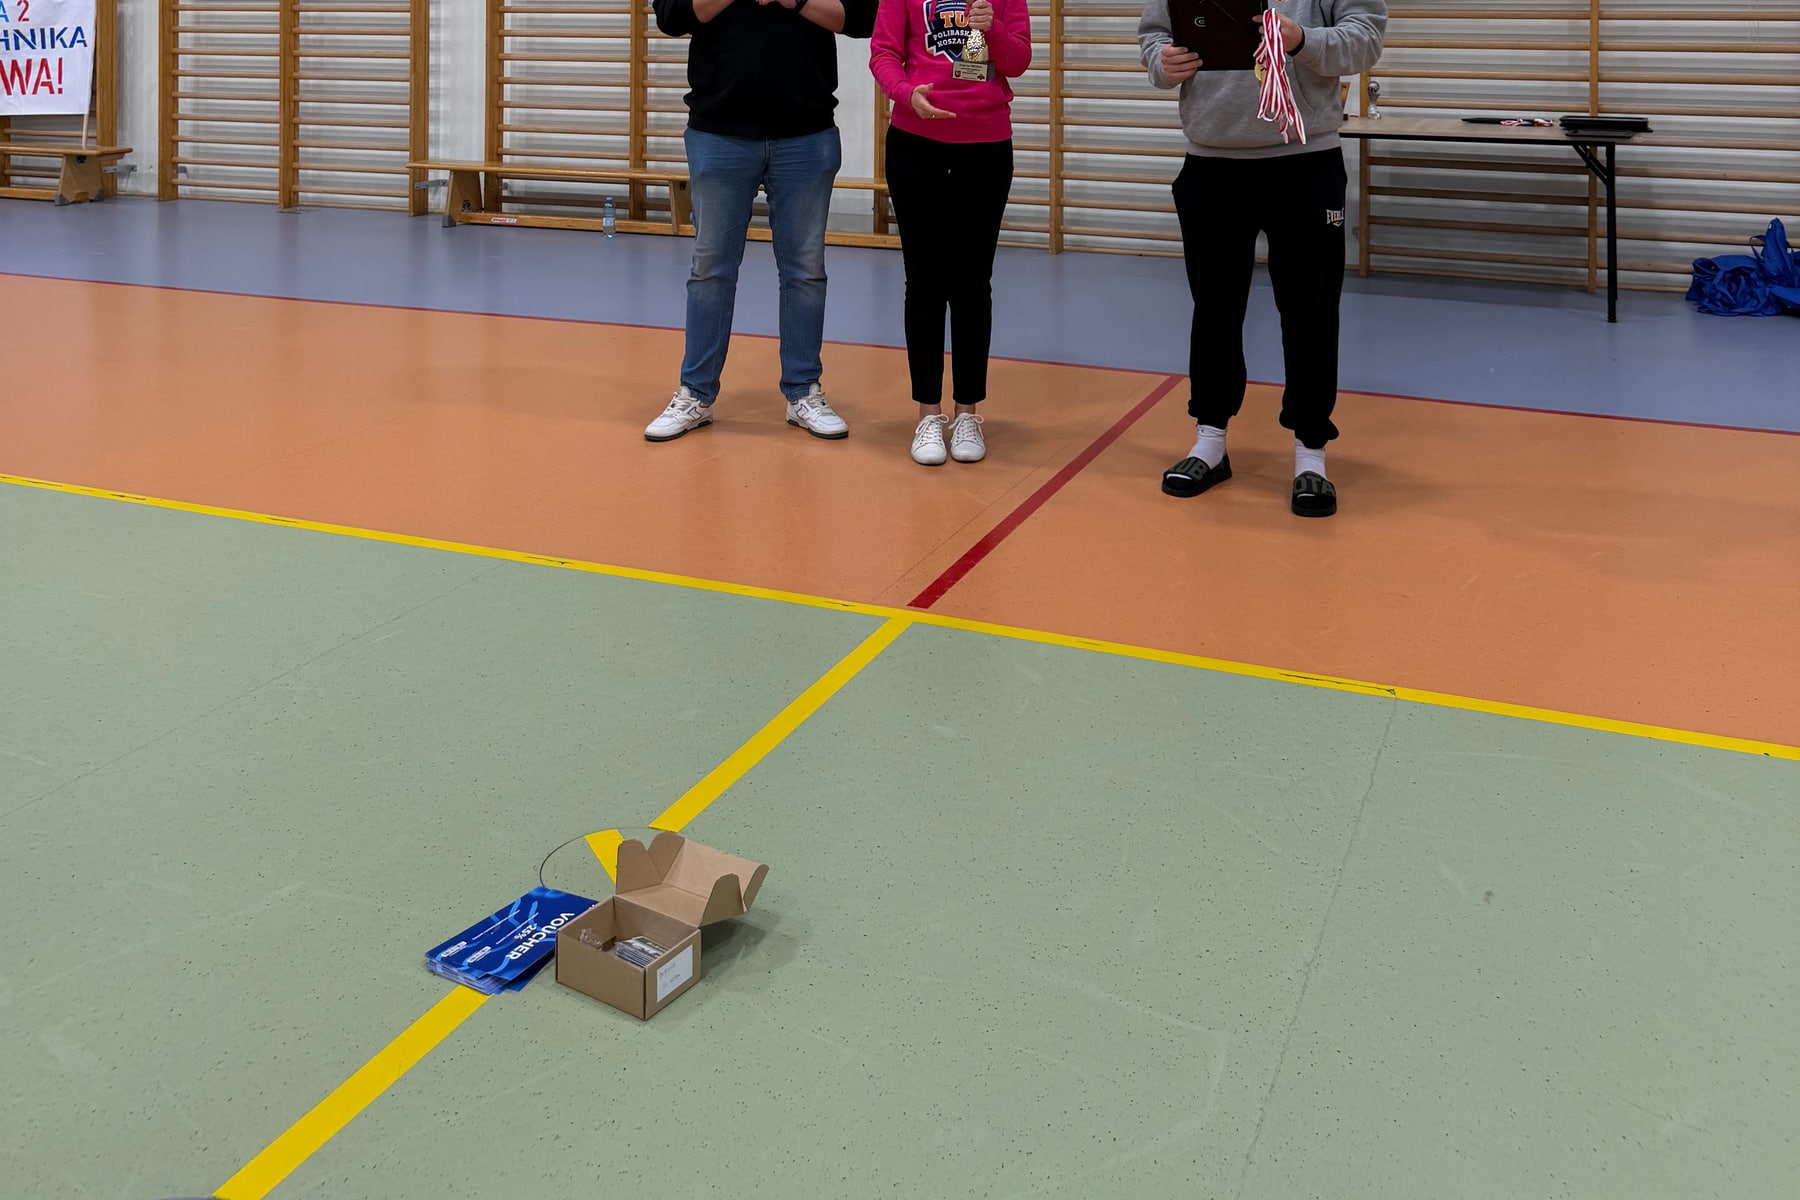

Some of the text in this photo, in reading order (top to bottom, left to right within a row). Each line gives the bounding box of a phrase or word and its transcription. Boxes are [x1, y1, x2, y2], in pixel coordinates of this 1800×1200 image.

[17, 0, 30, 22] 2
[940, 11, 969, 28] TU
[508, 913, 575, 960] VOUCHER
